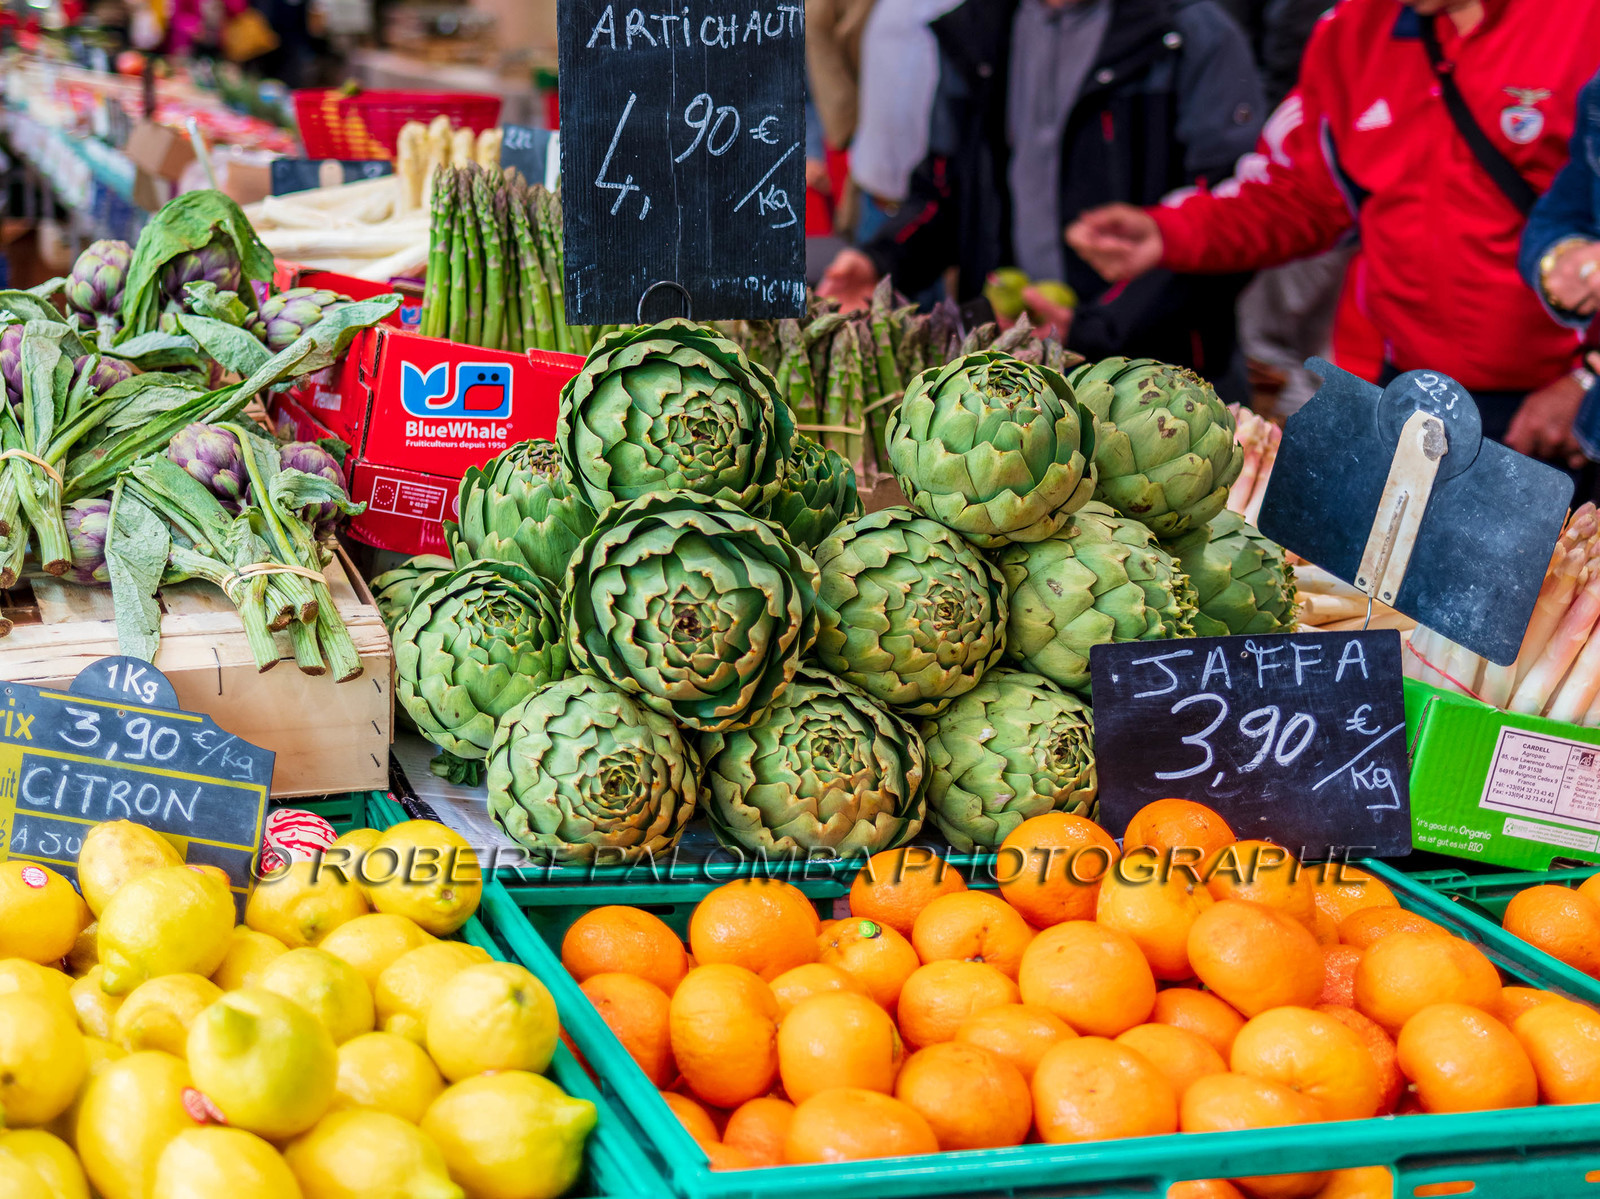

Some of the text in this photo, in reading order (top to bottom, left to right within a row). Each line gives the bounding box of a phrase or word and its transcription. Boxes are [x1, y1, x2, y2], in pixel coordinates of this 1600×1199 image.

[459, 441, 486, 450] depuis
[488, 441, 507, 449] 1950
[1132, 638, 1369, 698] JAFFA
[57, 706, 181, 761] 3,90
[1155, 692, 1318, 788] 3,90
[1522, 743, 1550, 753] CARDELL
[1520, 757, 1544, 767] Lawrence
[1514, 770, 1537, 780] Avignon
[1537, 775, 1554, 783] Cedex
[1517, 778, 1536, 787] France
[1459, 826, 1492, 840] Organic
[1468, 842, 1484, 853] BIO
